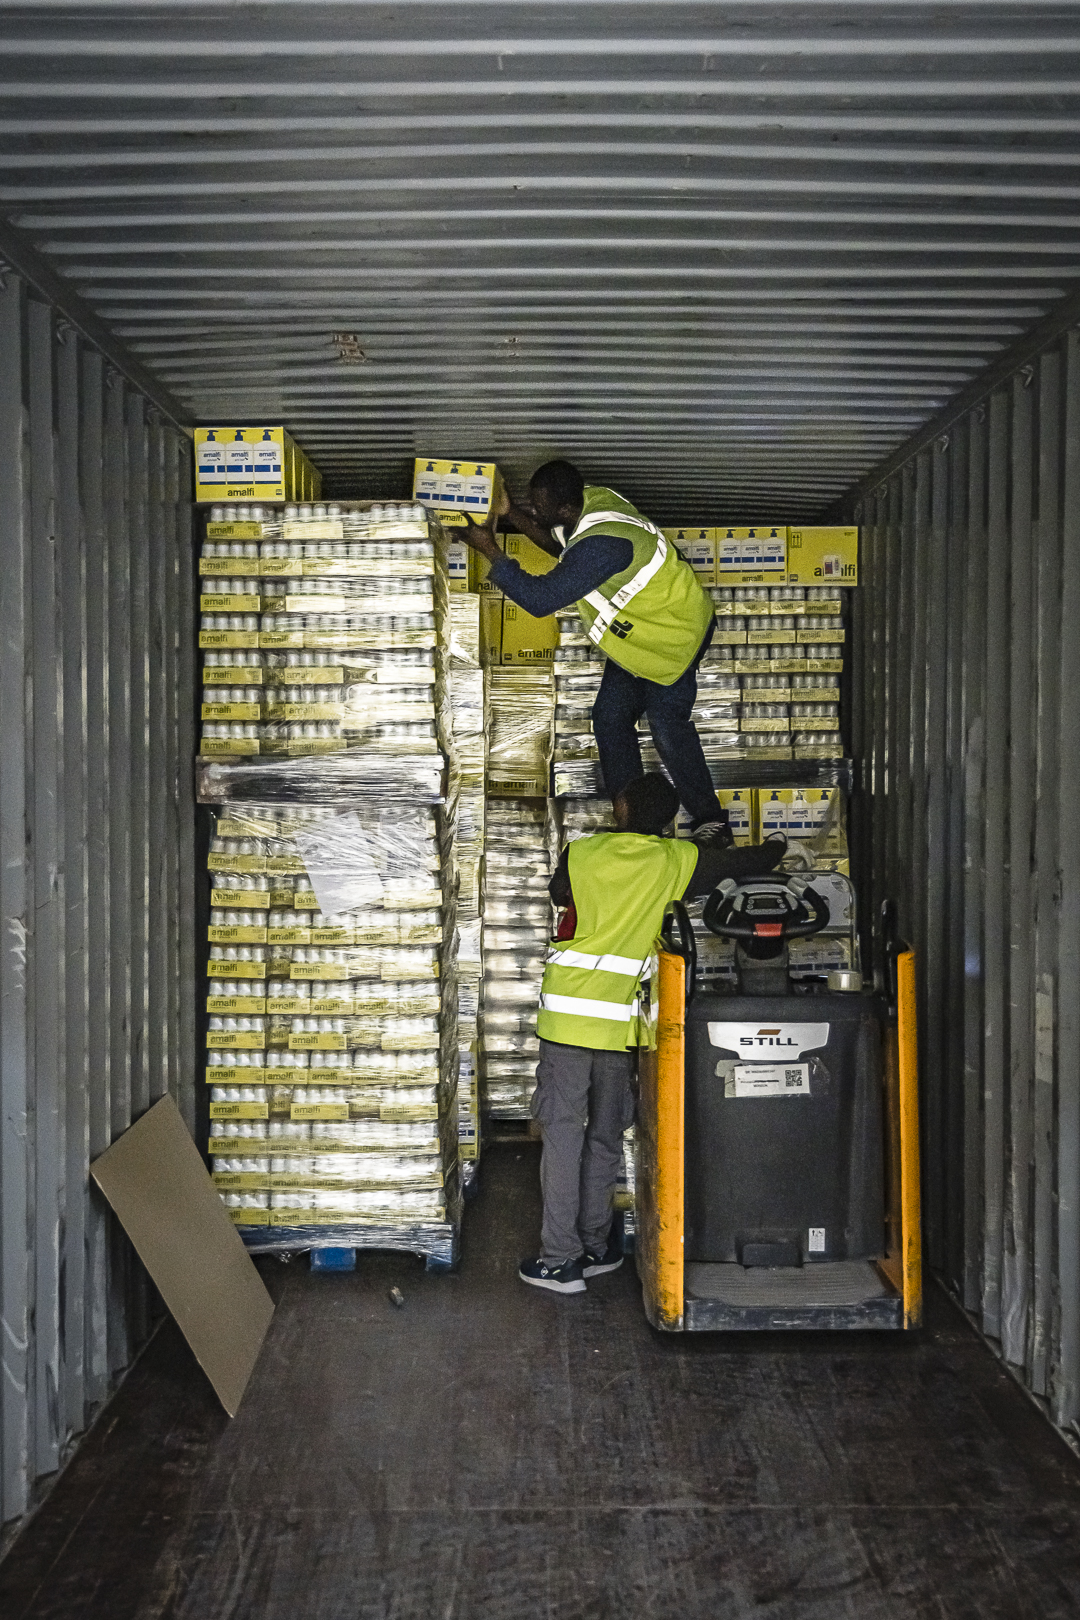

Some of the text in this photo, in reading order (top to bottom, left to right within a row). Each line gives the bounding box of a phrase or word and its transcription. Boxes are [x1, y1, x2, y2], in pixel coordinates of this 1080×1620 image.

[227, 488, 255, 497] amalfi
[438, 514, 463, 522] amalfi
[209, 526, 235, 535] amalfi
[201, 562, 228, 570] amalfi
[814, 564, 856, 577] alfi
[204, 598, 231, 606] amalfi
[201, 634, 228, 642] amalfi
[517, 648, 553, 658] amalfi
[205, 671, 232, 679] amalfi
[205, 706, 231, 714] amalfi
[204, 742, 231, 750] amalfi
[211, 929, 238, 937] amalfi
[314, 932, 340, 941] amalfi
[211, 964, 238, 972] amalfi
[294, 966, 320, 974] amalfi
[211, 999, 237, 1007] amalfi
[270, 1002, 296, 1010] amalfi
[210, 1035, 237, 1043] amalfi
[292, 1036, 319, 1044] amalfi
[739, 1037, 799, 1046] STILL
[209, 1070, 236, 1078] amalfi
[267, 1072, 293, 1080] amalfi
[311, 1072, 337, 1080] amalfi
[213, 1106, 240, 1114] amalfi
[294, 1106, 320, 1114] amalfi
[212, 1140, 239, 1149] amalfi
[214, 1176, 241, 1184] amalfi
